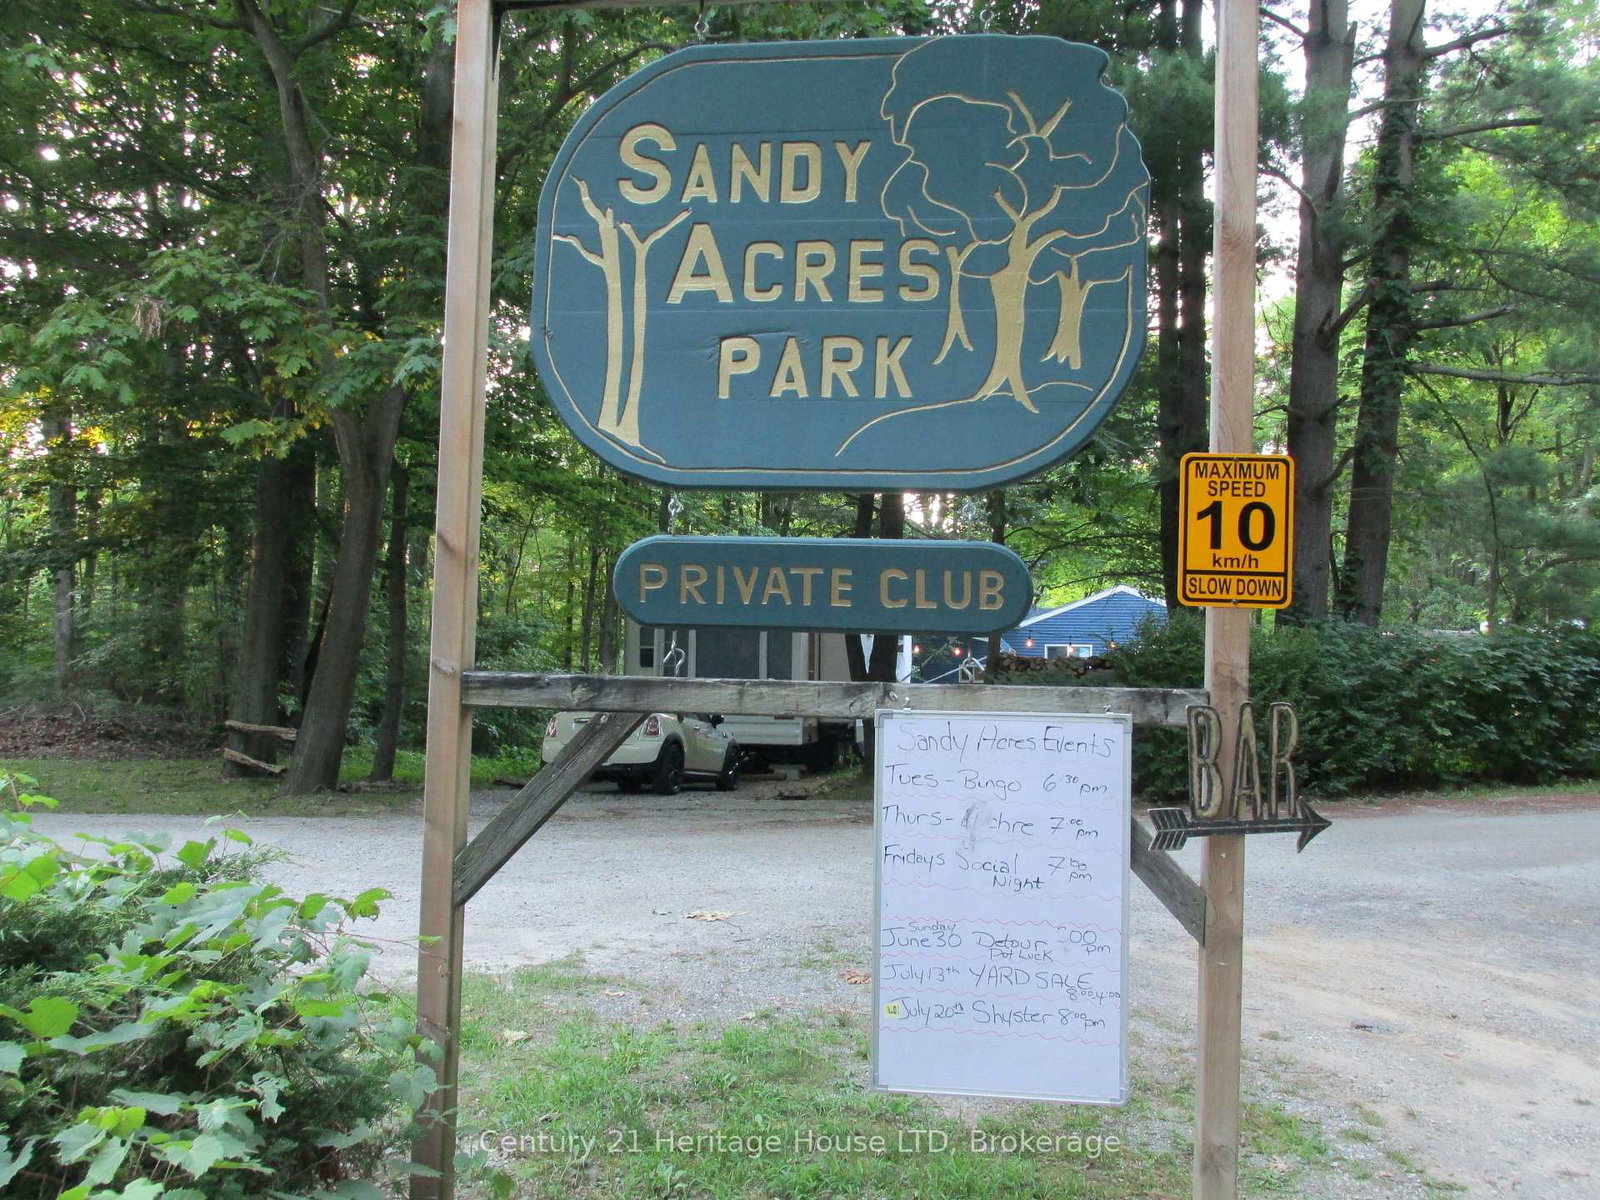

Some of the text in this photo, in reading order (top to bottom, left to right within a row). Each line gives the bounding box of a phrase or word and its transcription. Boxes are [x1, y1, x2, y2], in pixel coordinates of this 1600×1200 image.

[617, 122, 872, 205] SANDY
[666, 222, 941, 306] ACRES
[718, 335, 914, 401] PARK
[1195, 462, 1279, 480] MAXIMUM
[1207, 480, 1266, 497] SPEED
[1196, 500, 1276, 552] 10
[1212, 553, 1259, 569] km/h
[638, 563, 1005, 610] PRIVATE CLUB
[1188, 577, 1282, 597] SLOW DOWN
[898, 721, 968, 762] Sandy
[1043, 726, 1115, 758] Events
[1186, 701, 1299, 821] BAR
[957, 769, 1022, 800] Bingo
[883, 844, 946, 873] Fridays
[992, 874, 1045, 893] Night
[881, 926, 932, 948] June
[932, 930, 962, 948] 30
[908, 921, 957, 935] Sunday
[880, 962, 925, 984] July
[968, 964, 1030, 989] YARD
[1034, 972, 1093, 990] SALE
[888, 996, 931, 1028] July
